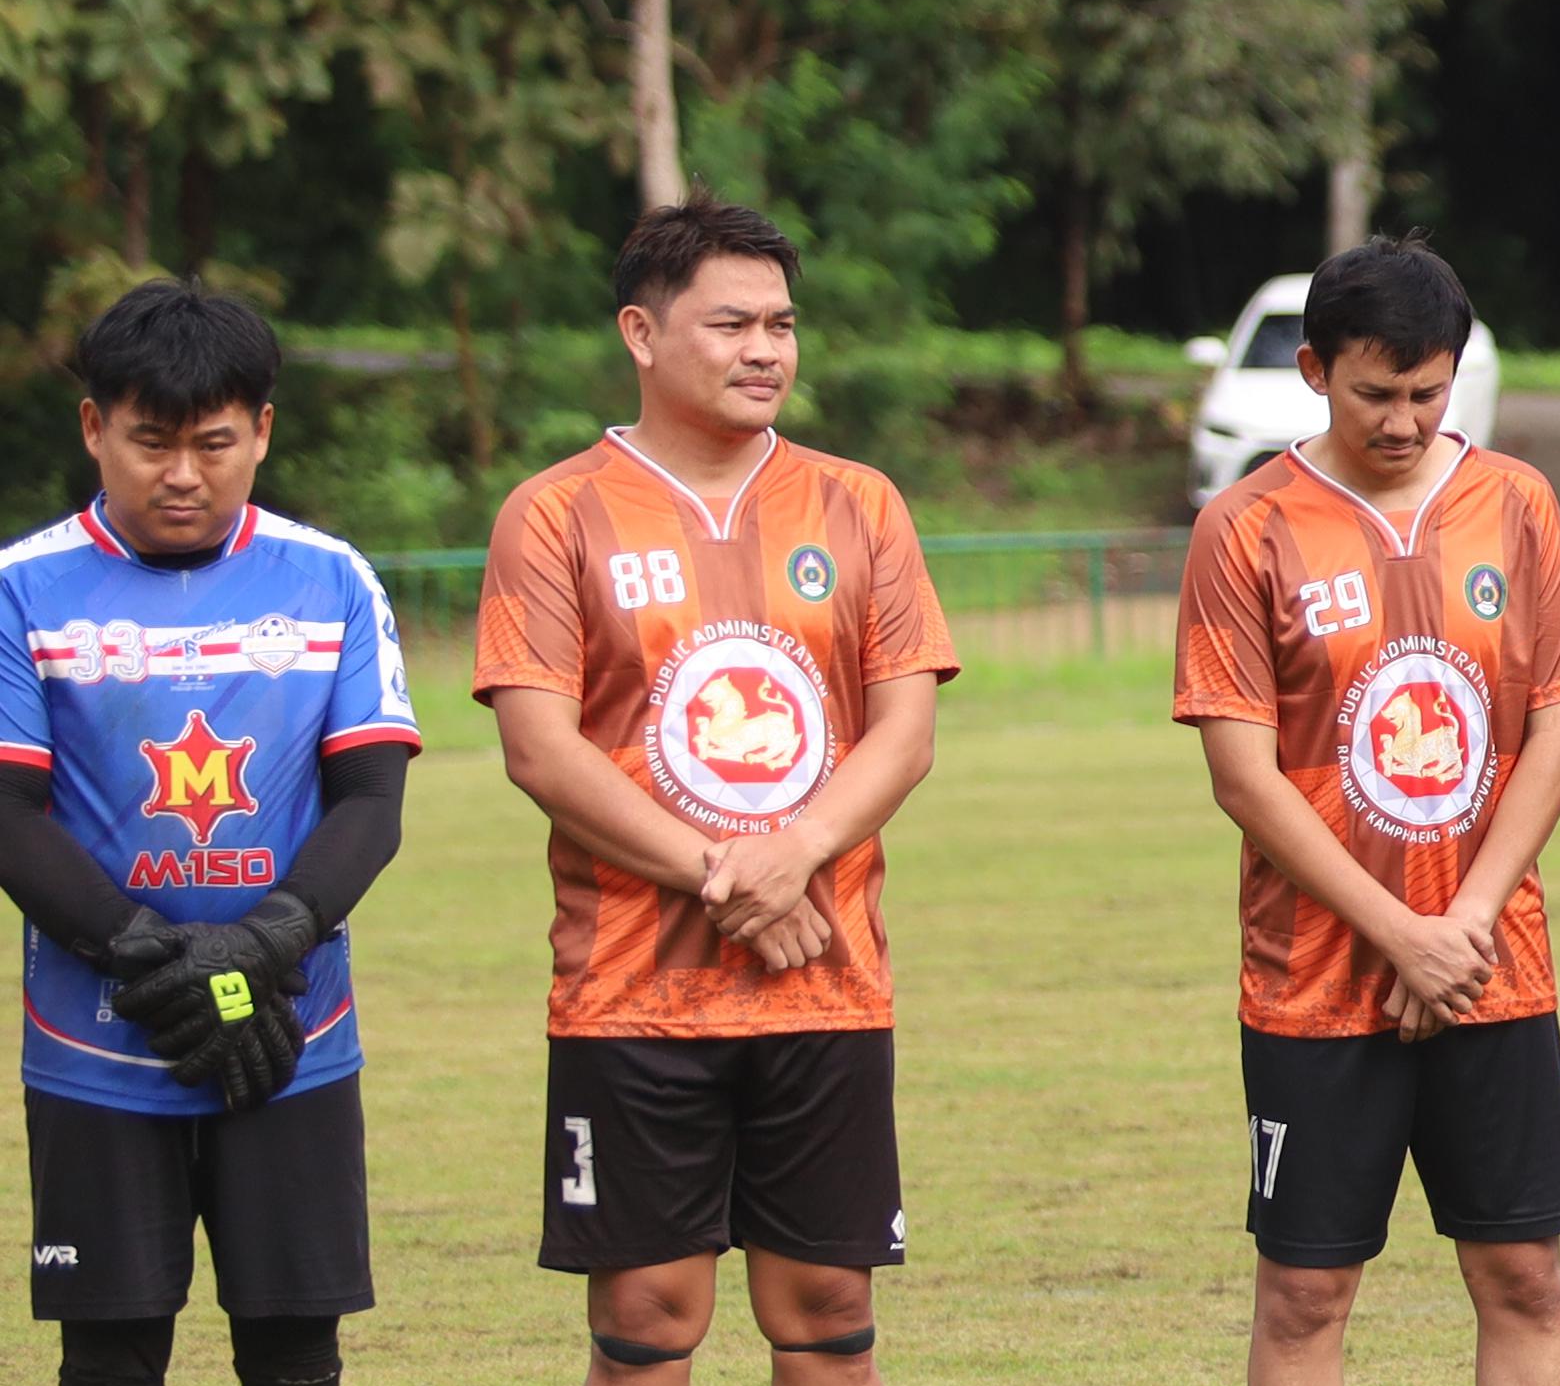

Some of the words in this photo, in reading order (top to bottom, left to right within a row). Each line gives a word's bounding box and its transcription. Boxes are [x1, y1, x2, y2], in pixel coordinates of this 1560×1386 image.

[609, 549, 687, 611] 88
[1299, 569, 1373, 637] 29
[64, 619, 149, 684] 33
[650, 639, 690, 706] PUBLIC
[692, 620, 828, 698] ADMINISTRATION
[1337, 661, 1378, 725] PUBLIC
[164, 749, 236, 808] M
[677, 795, 770, 833] KAMPHAENG
[127, 847, 275, 889] M-150
[562, 1116, 597, 1207] 3
